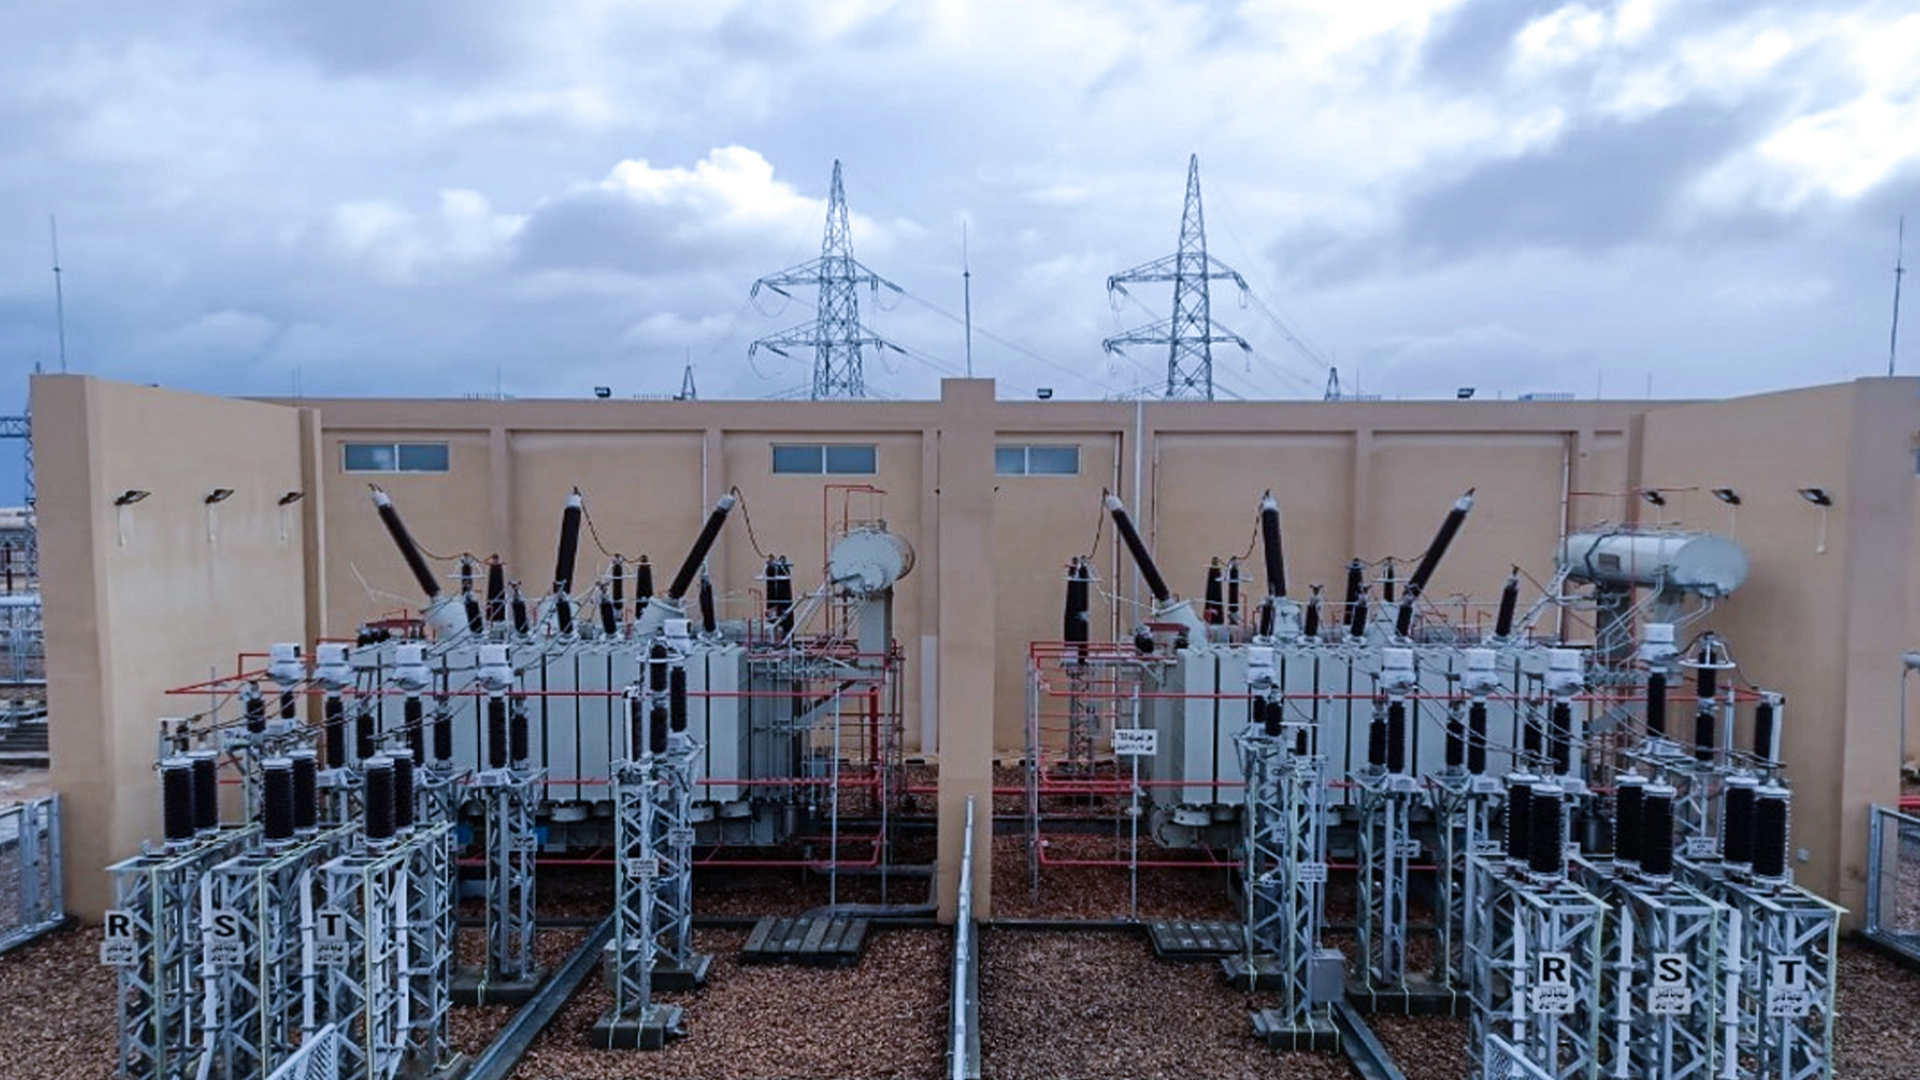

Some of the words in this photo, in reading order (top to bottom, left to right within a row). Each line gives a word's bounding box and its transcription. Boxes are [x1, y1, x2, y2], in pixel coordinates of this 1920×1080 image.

[108, 914, 130, 937] R
[214, 914, 235, 937] S
[320, 913, 342, 936] T
[1543, 957, 1566, 982] R
[1659, 957, 1682, 982] S
[1778, 960, 1802, 985] T
